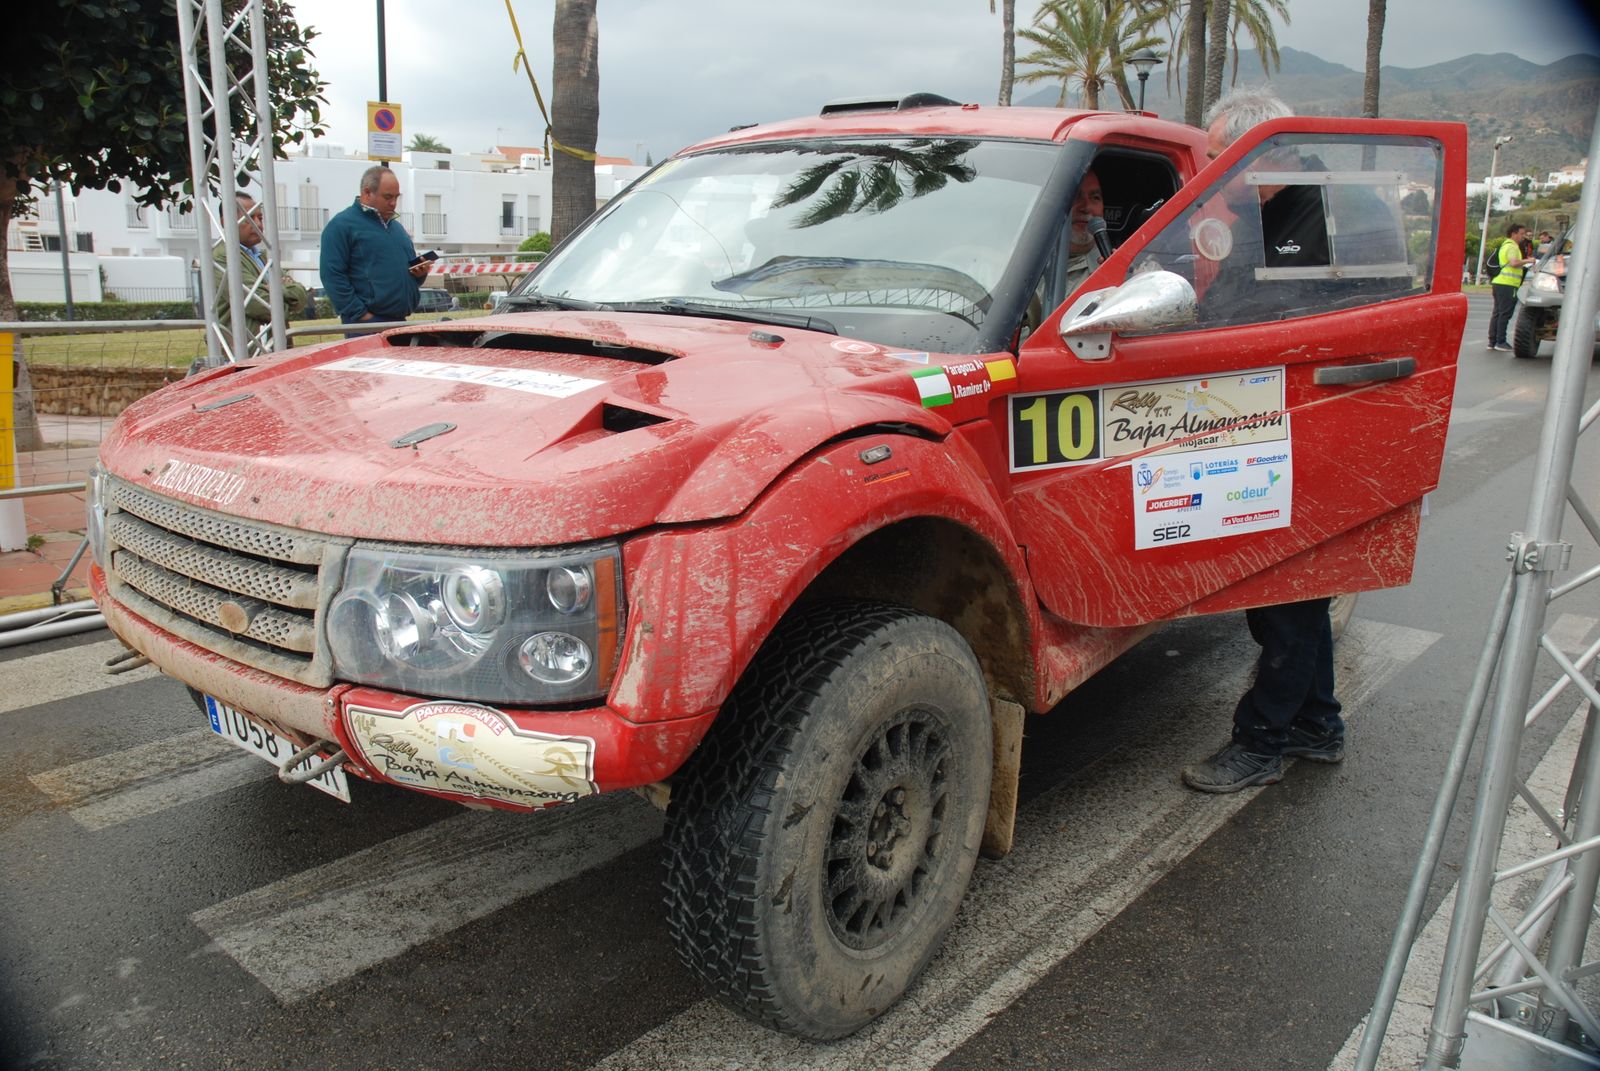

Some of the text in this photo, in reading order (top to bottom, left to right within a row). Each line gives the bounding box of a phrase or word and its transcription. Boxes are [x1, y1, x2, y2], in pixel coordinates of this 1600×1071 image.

[1110, 390, 1173, 418] Rally T.T.
[1020, 394, 1095, 464] 10
[1106, 409, 1283, 448] Baja Almanzora
[1247, 453, 1288, 465] BFGoodrich
[1137, 469, 1153, 487] CSD
[1149, 497, 1188, 510] JOKERBET
[1226, 487, 1269, 501] codeur
[1153, 524, 1191, 542] SER
[1223, 518, 1232, 526] La
[219, 702, 279, 758] 1058
[414, 704, 508, 737] PARTICIPANTE
[369, 733, 419, 762] Rally
[373, 753, 440, 781] Baja
[442, 770, 580, 802] Almanzora
